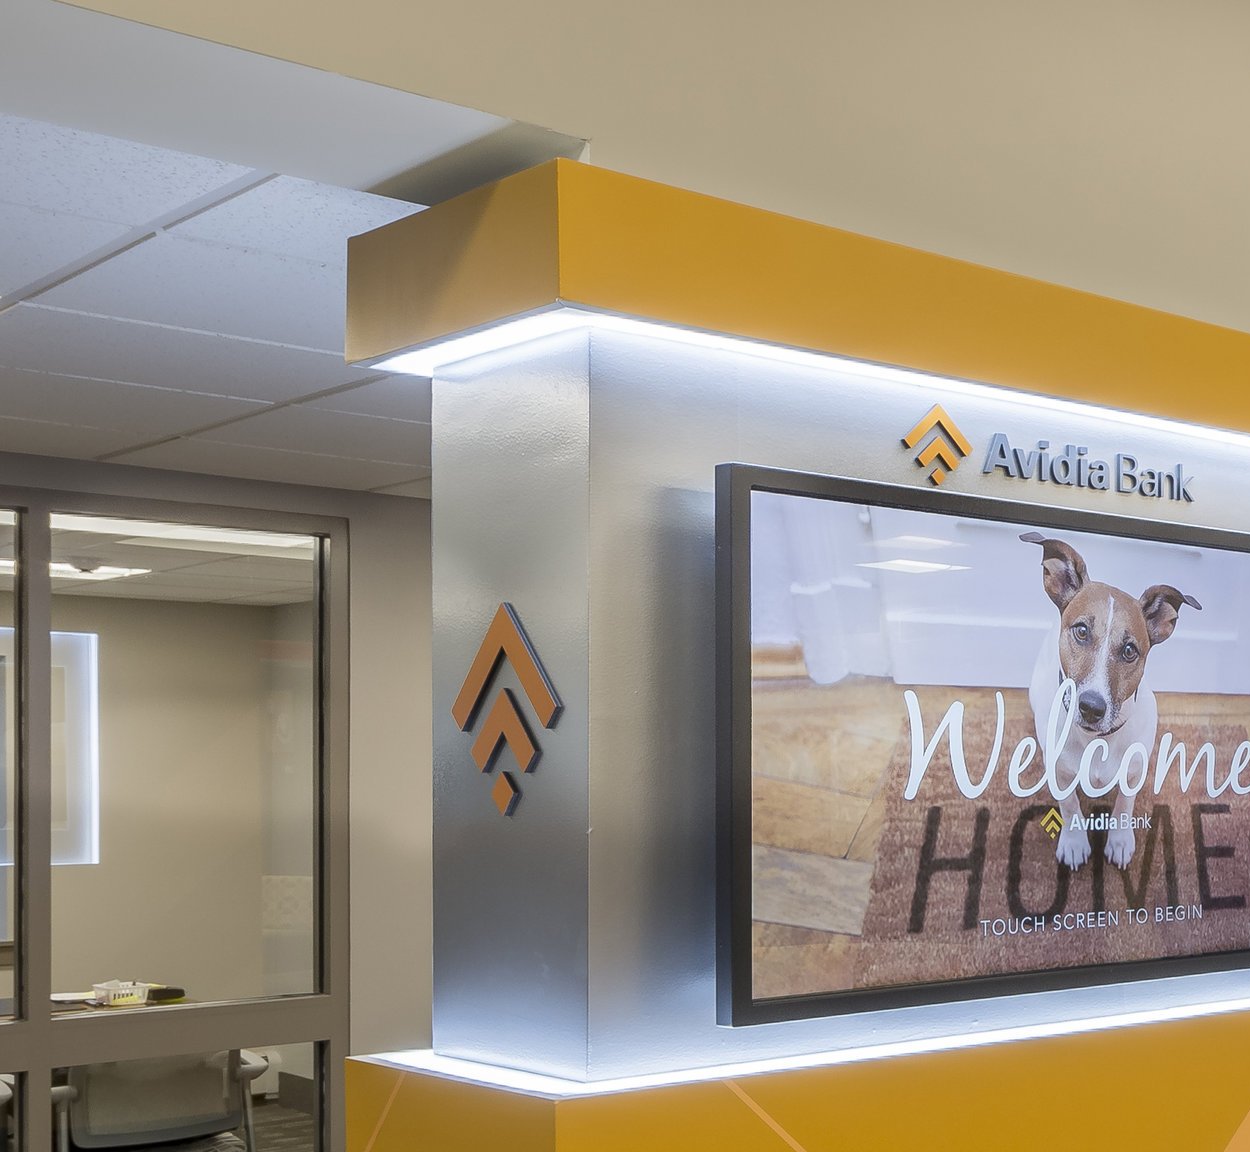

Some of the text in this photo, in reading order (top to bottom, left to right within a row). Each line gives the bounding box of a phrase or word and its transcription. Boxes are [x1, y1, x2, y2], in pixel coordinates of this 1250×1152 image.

[982, 432, 1195, 502] Avidia Bank
[1069, 812, 1153, 832] Avidia Bank
[906, 804, 1247, 934] HOME
[980, 903, 1204, 938] TOUCH SCREEN TO BEGIN
